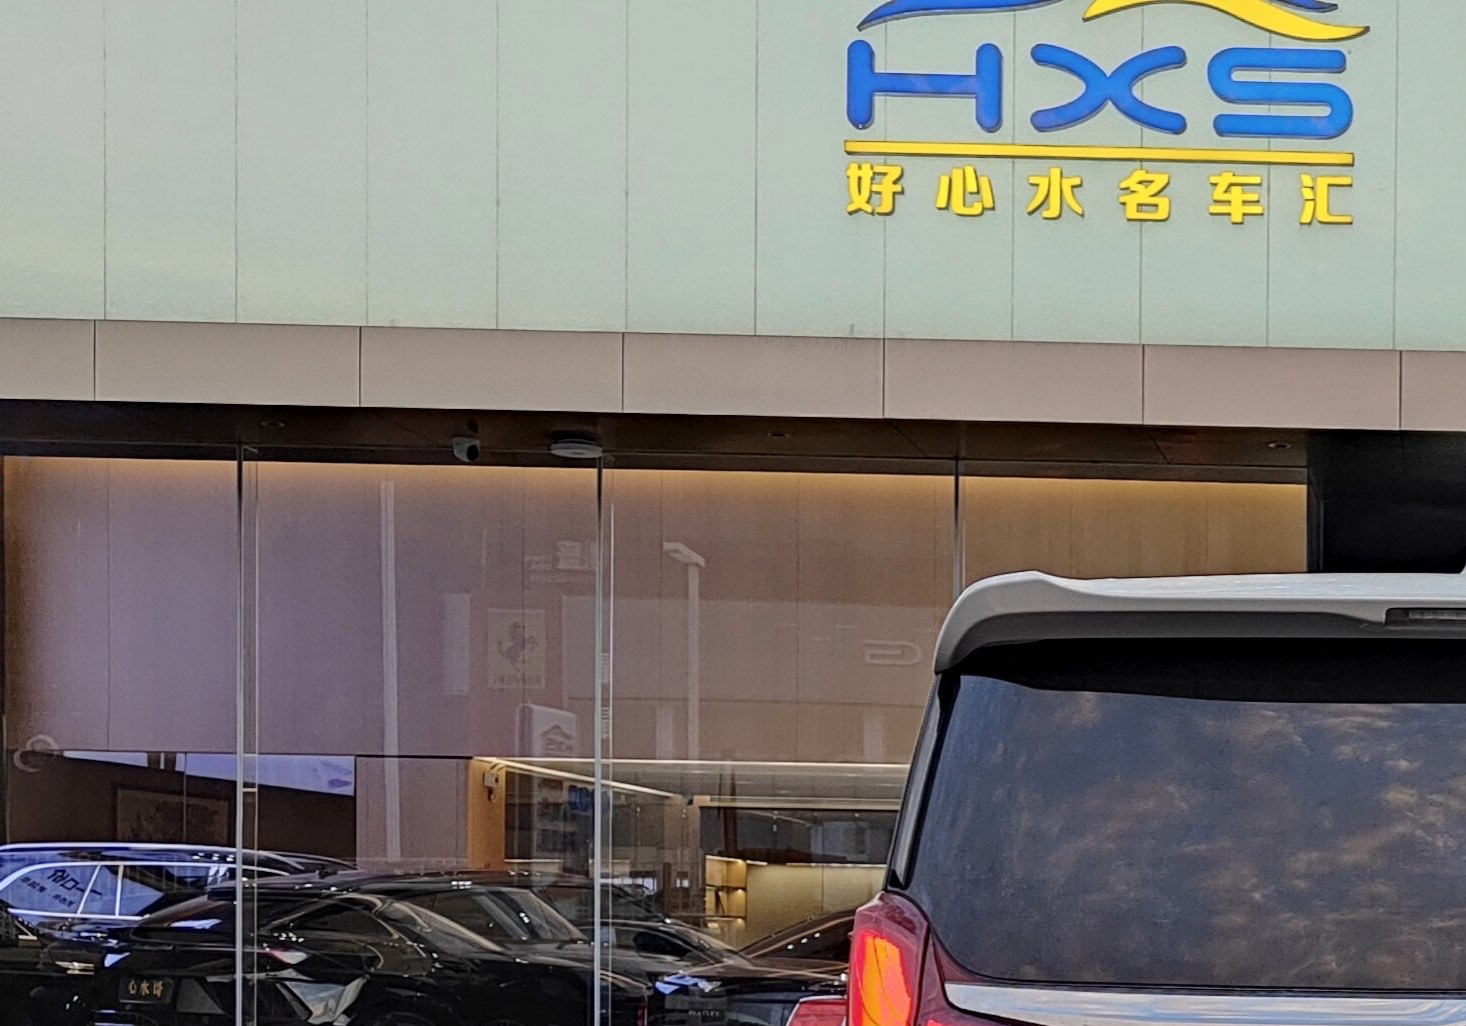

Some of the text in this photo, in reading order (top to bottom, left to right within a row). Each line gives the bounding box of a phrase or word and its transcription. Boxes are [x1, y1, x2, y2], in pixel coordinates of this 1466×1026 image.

[847, 40, 1353, 139] HXS
[846, 163, 1354, 224] 好心水名车汇
